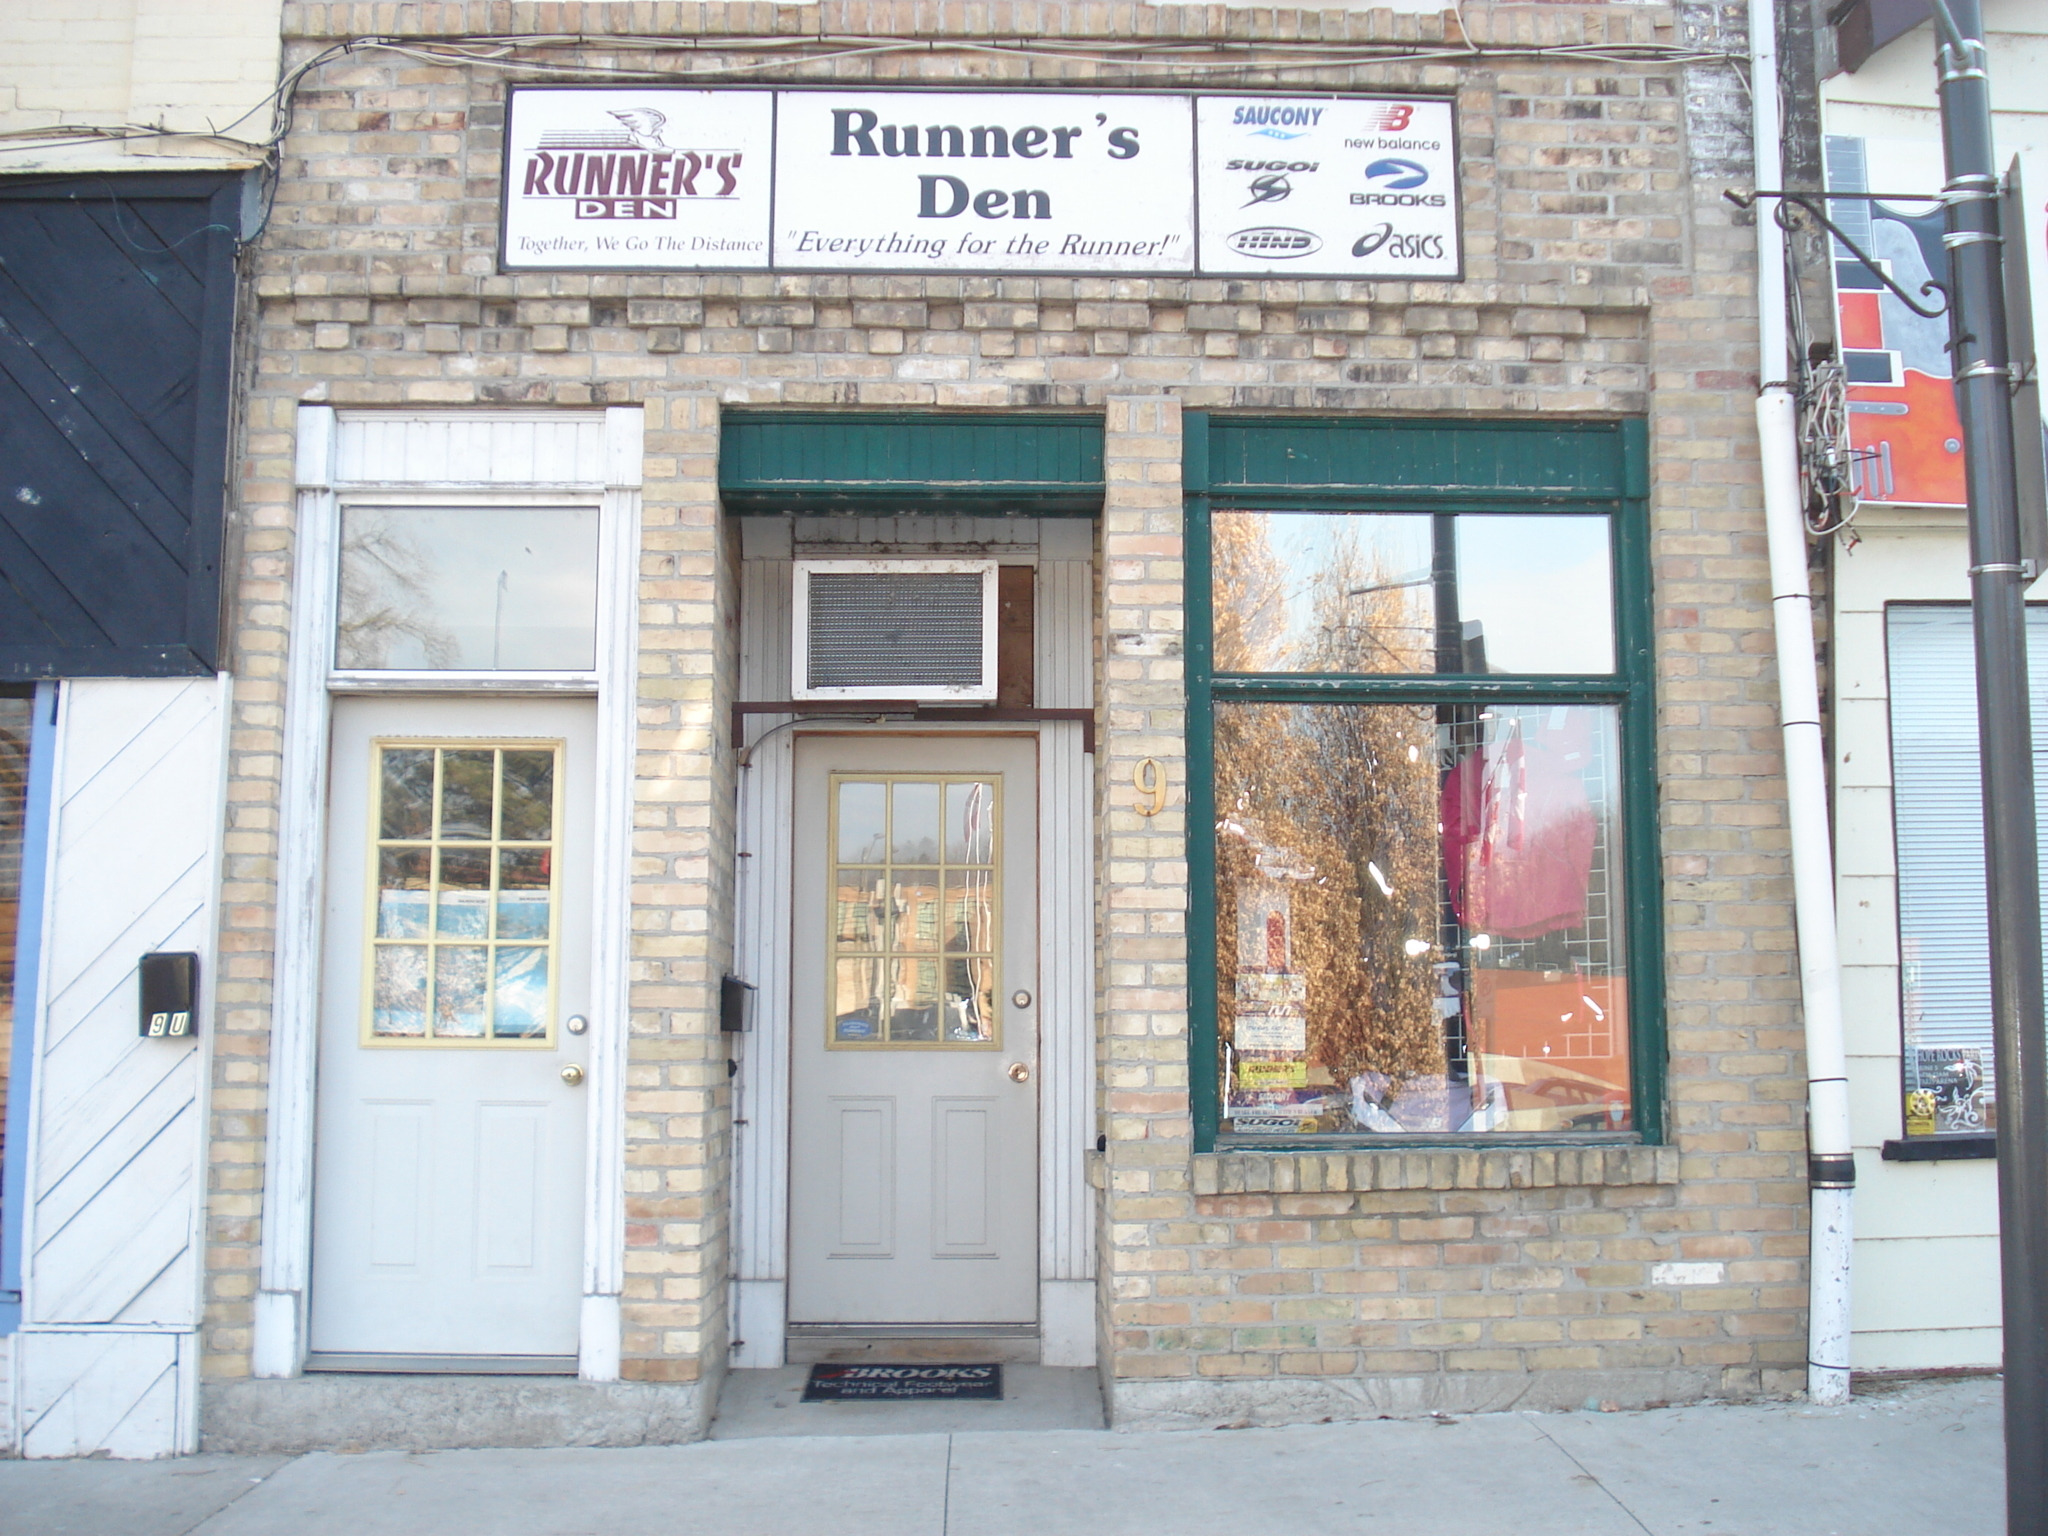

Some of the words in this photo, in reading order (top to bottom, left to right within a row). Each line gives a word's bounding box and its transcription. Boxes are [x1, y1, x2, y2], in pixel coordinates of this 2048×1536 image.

[1233, 105, 1324, 126] SAUCONY
[830, 108, 1141, 160] Runner's
[1344, 137, 1375, 149] new
[1378, 136, 1441, 151] balance
[523, 150, 743, 196] RUNNER'S
[917, 174, 1053, 219] Den
[1349, 192, 1446, 207] BROOKS
[578, 200, 673, 218] DEN
[518, 235, 588, 256] Together,
[596, 236, 620, 251] We
[625, 236, 648, 251] Go
[655, 236, 685, 251] The
[690, 236, 763, 251] Distance
[955, 232, 997, 255] for
[1005, 235, 1049, 256] the
[1133, 757, 1167, 817] 9
[841, 1367, 993, 1379] BROOKS
